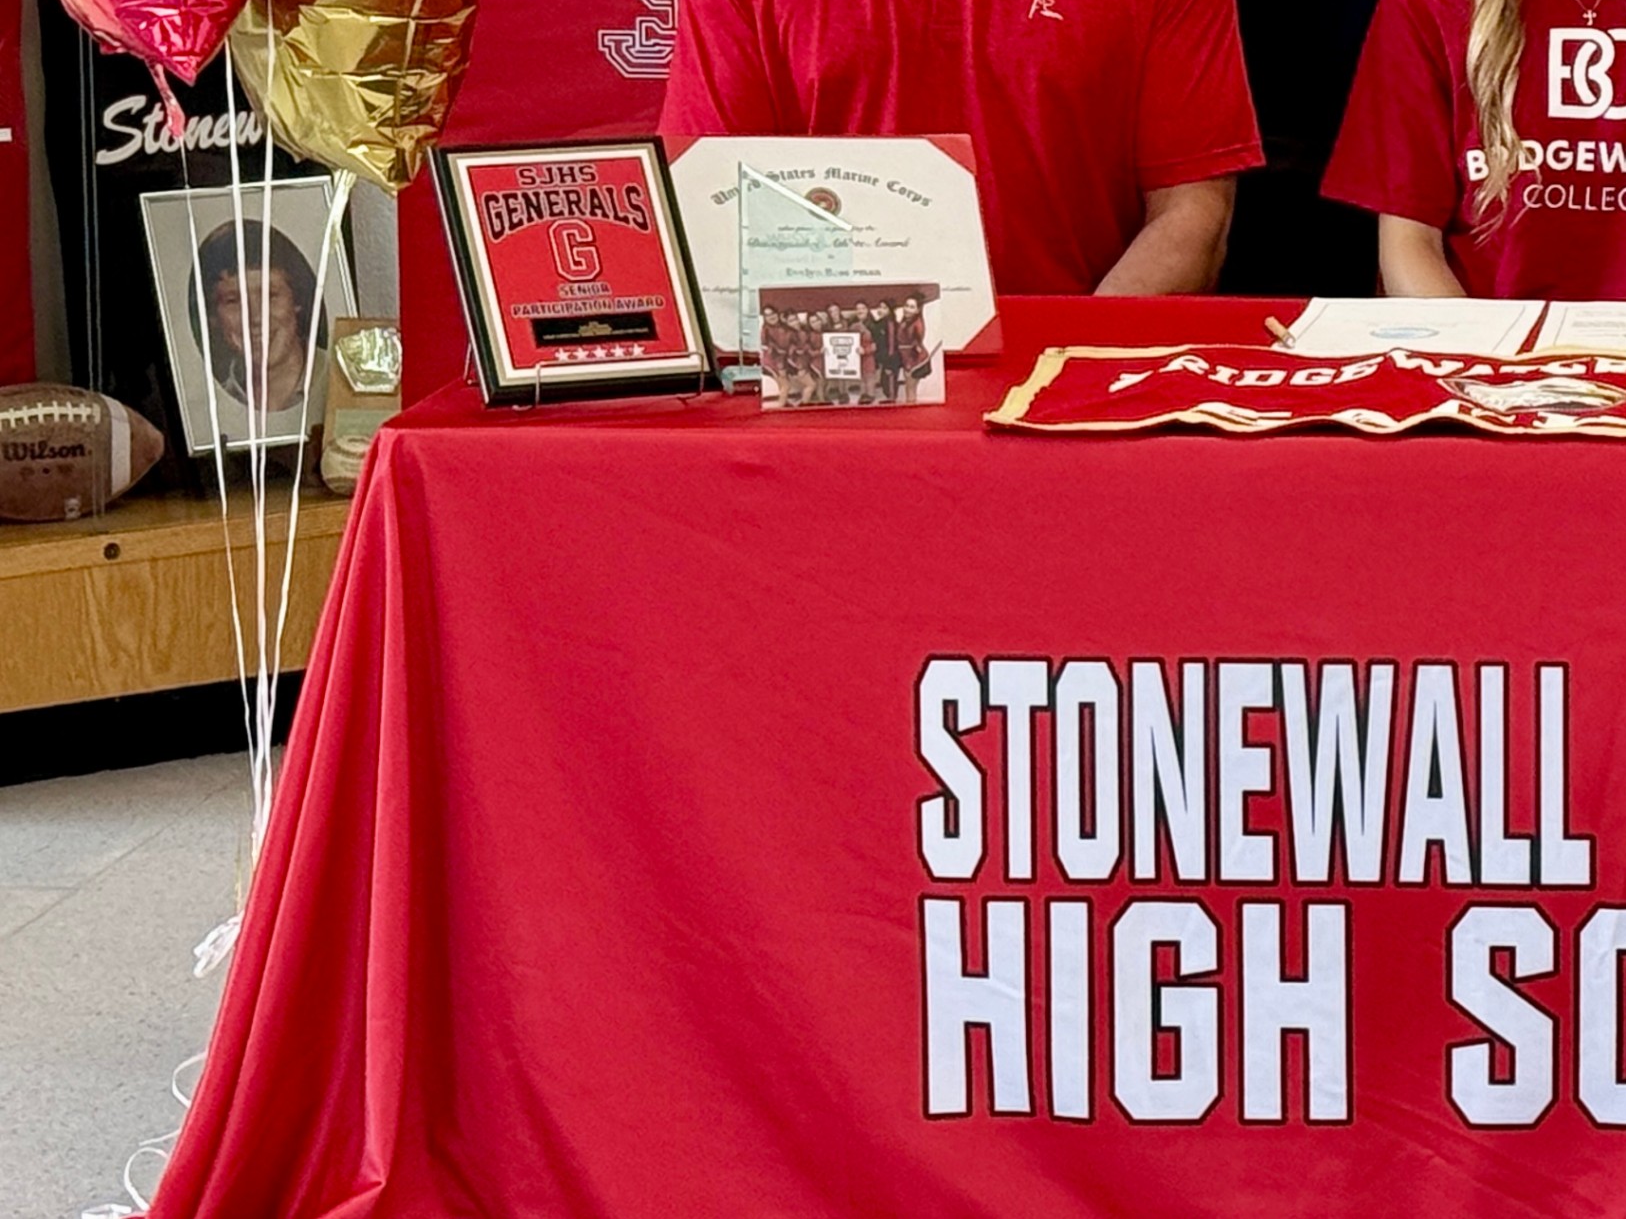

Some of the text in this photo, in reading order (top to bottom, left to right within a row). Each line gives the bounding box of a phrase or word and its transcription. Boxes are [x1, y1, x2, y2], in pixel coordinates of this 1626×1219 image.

[517, 165, 598, 186] SJHS
[824, 167, 880, 187] Marine
[886, 181, 932, 208] Corps
[482, 185, 650, 242] GENERALS
[549, 218, 601, 281] G
[512, 296, 664, 317] PARTICIPATION AWARD
[559, 283, 611, 297] SENIOR
[2, 440, 86, 462] Wilson
[917, 656, 1597, 887] STONEWALL
[919, 897, 1354, 1127] HIGH
